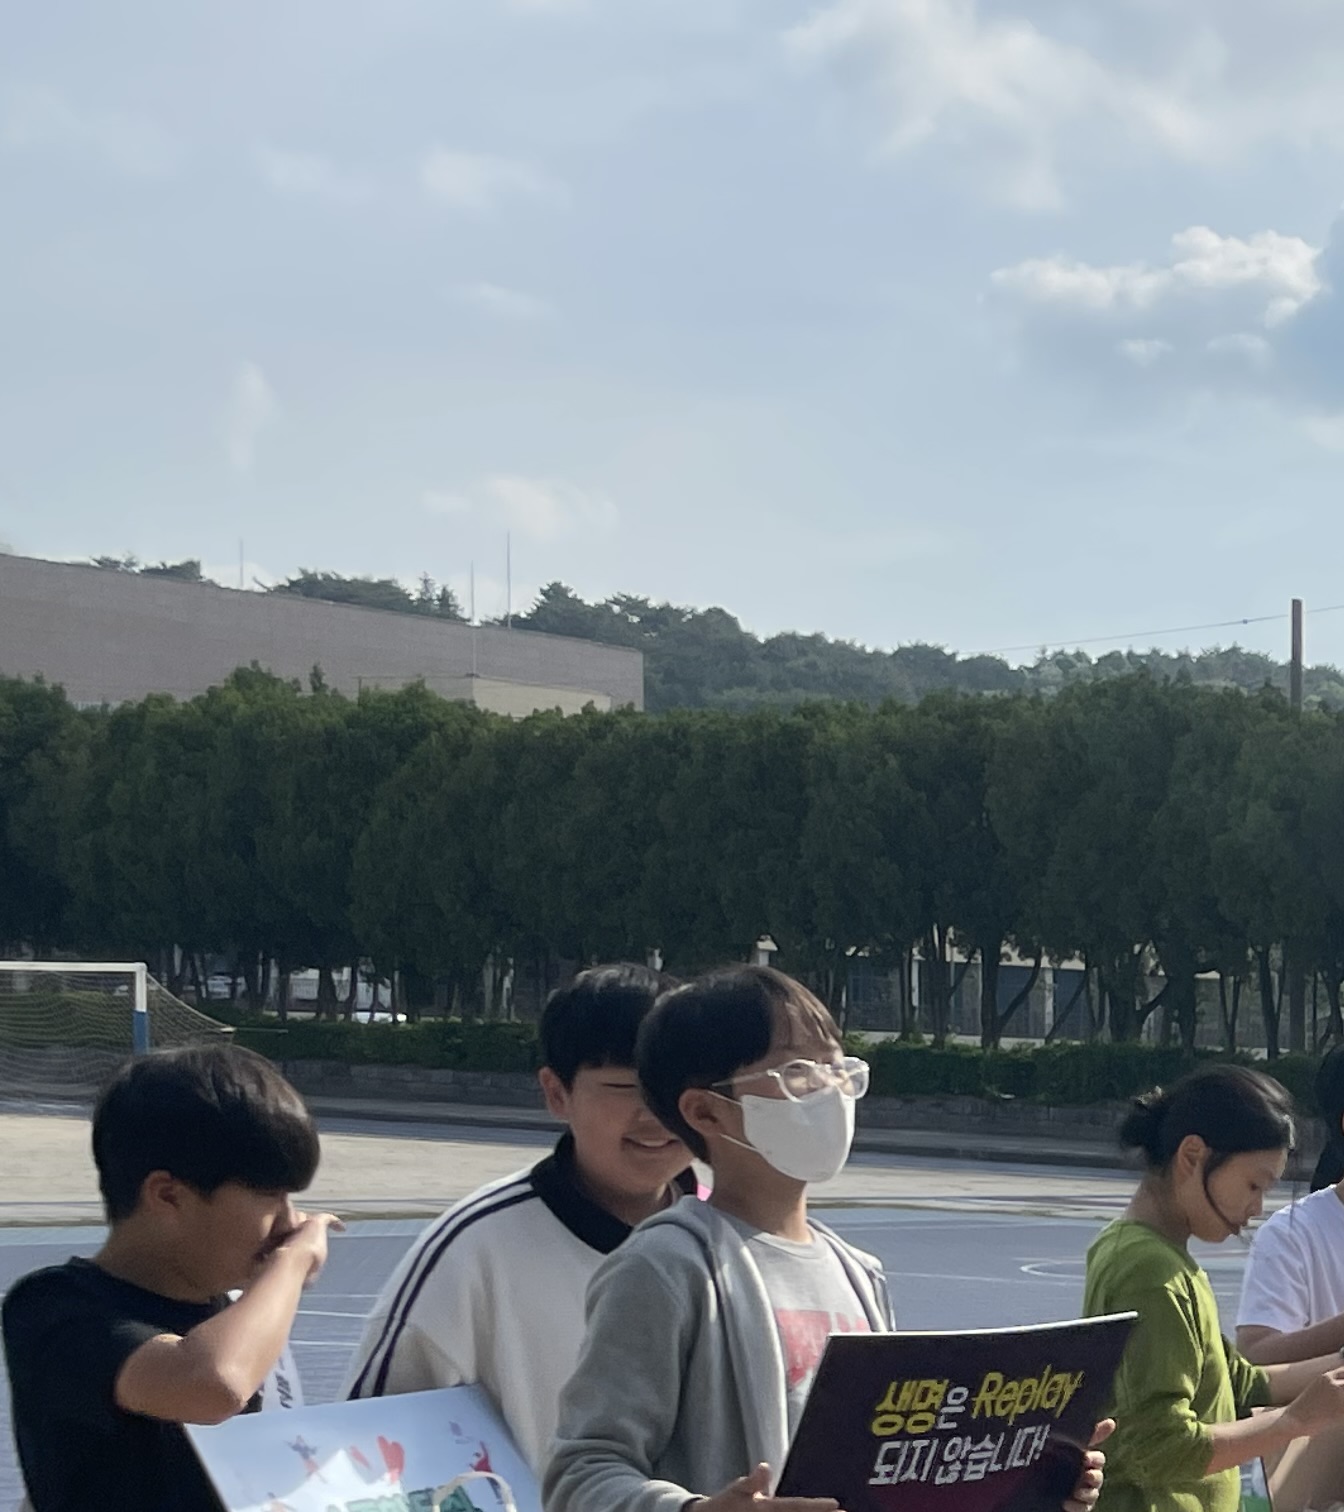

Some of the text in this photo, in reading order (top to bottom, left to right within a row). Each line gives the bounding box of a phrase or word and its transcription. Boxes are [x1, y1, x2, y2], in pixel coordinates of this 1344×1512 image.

[871, 1364, 1086, 1437] 생명은 Replay
[868, 1424, 1051, 1486] 되지 않습니다!
